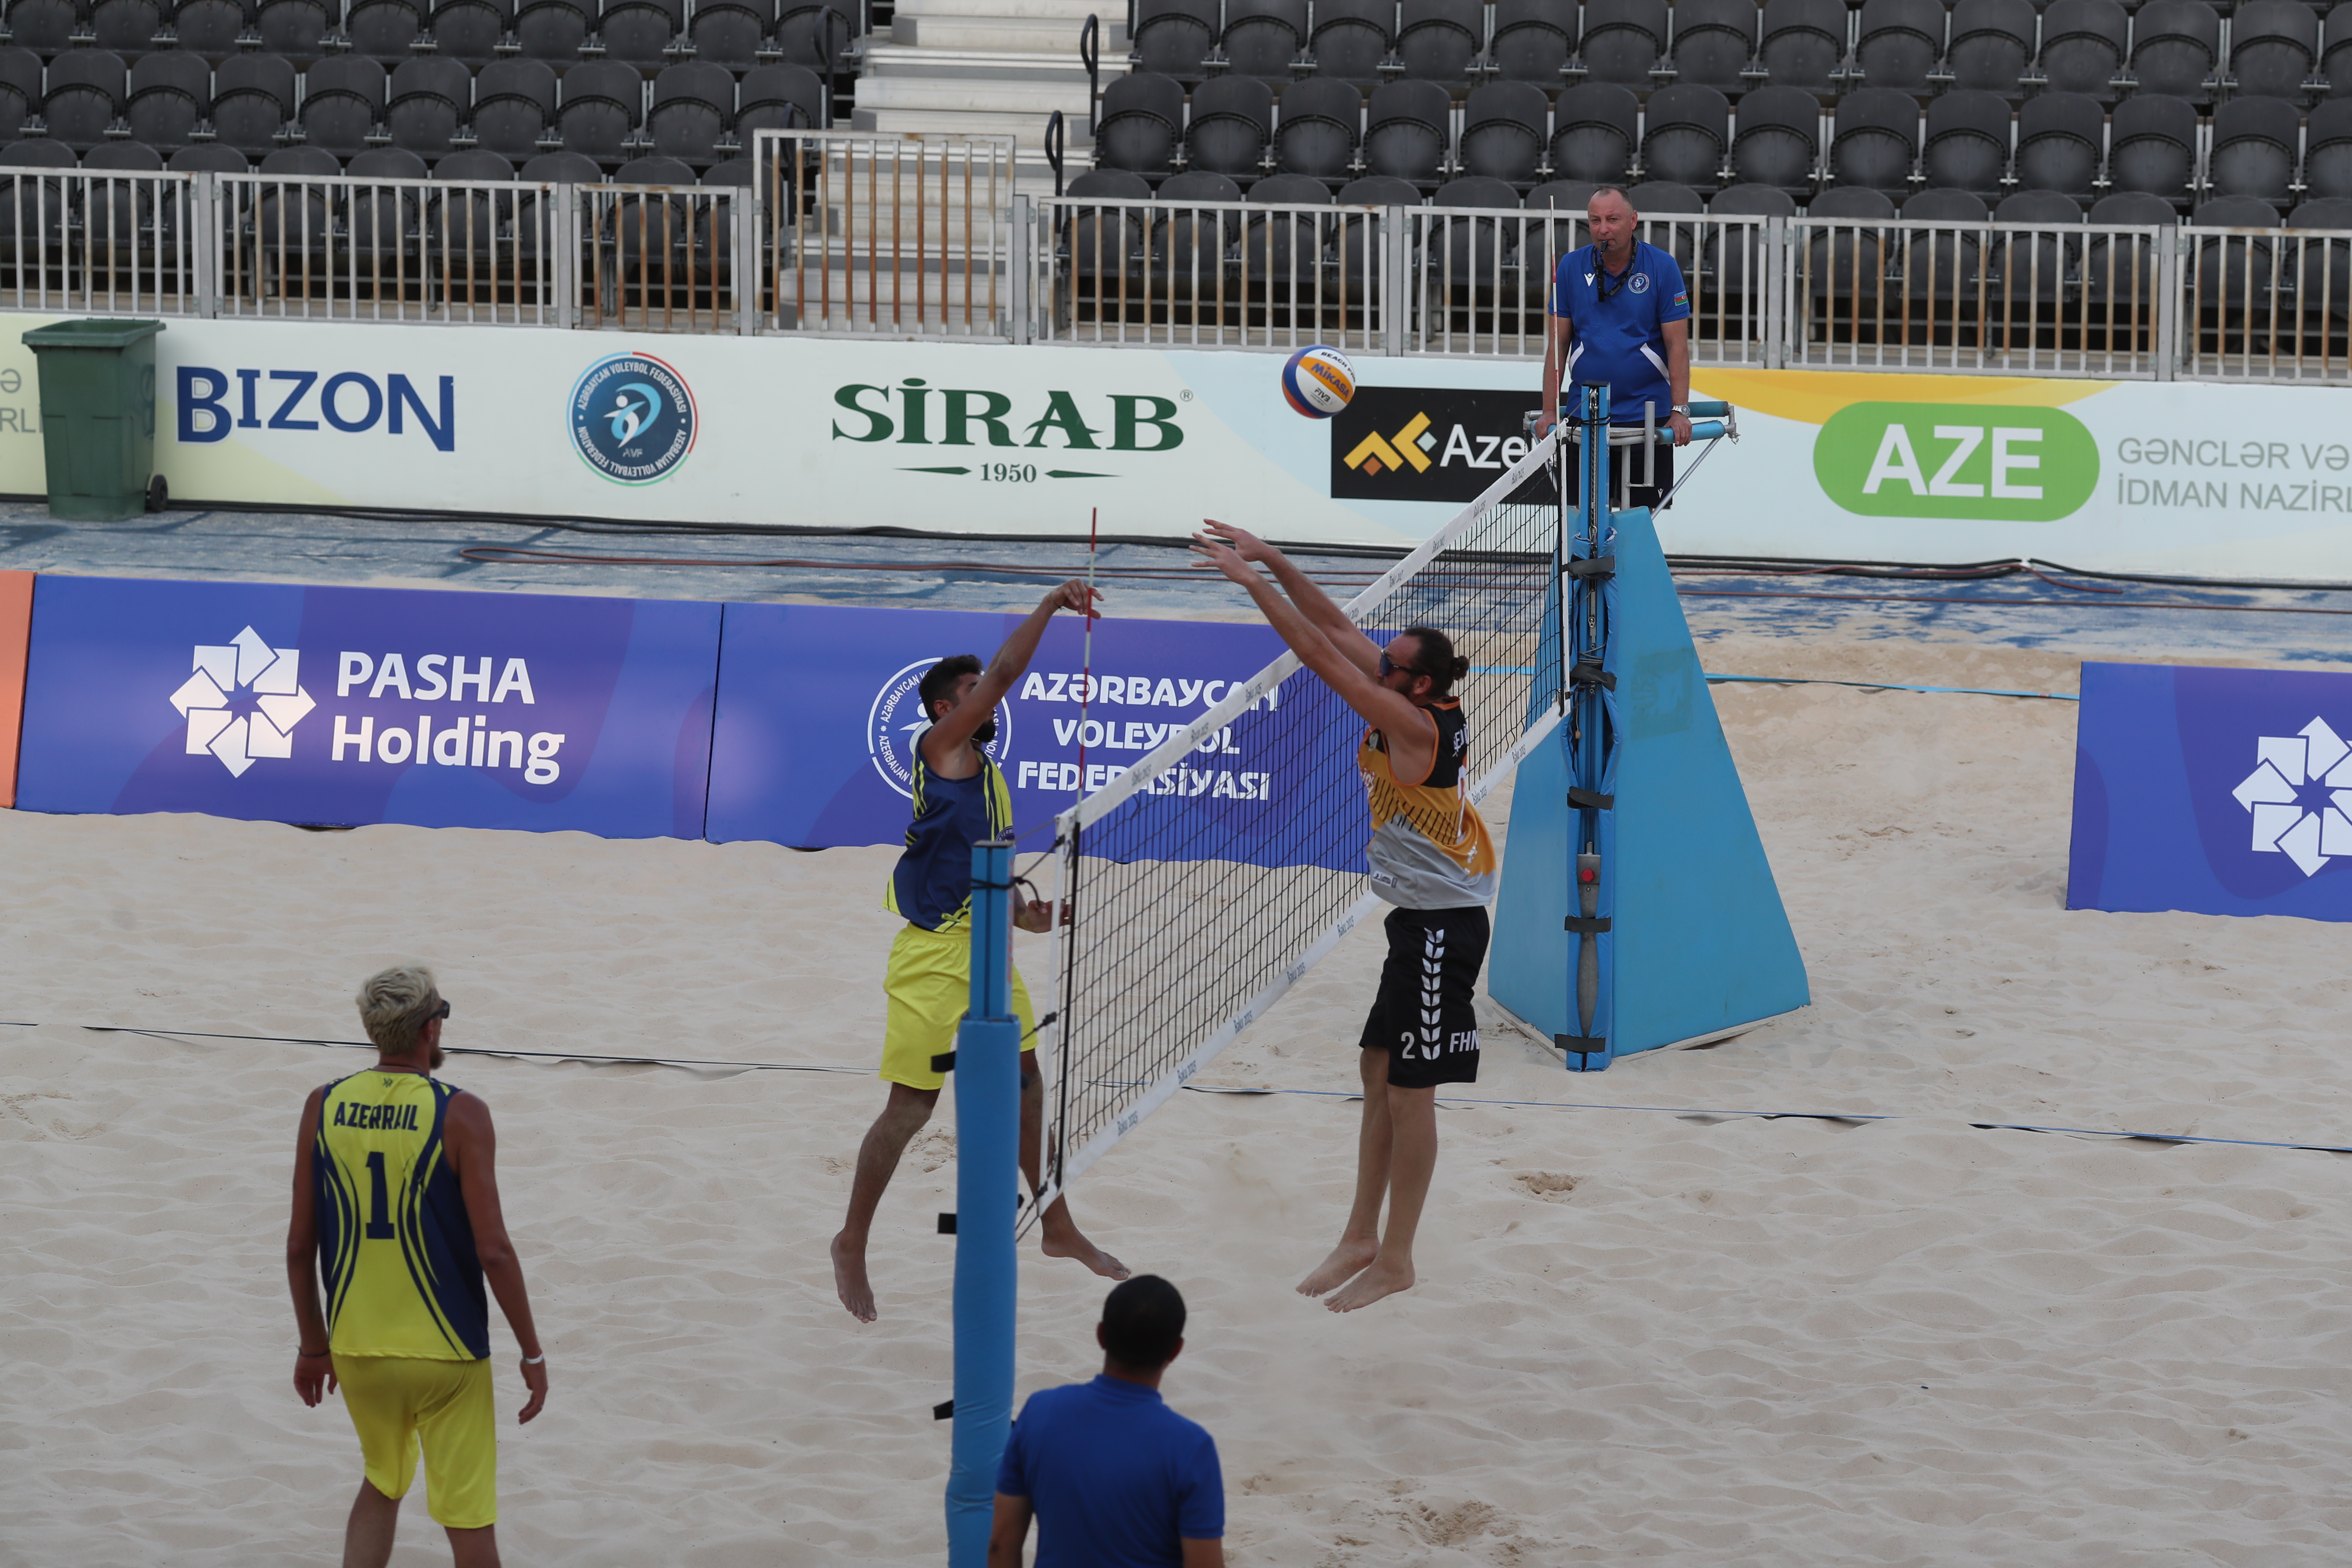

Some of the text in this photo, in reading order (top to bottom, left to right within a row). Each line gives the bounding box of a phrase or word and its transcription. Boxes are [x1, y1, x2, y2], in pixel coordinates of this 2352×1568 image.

[609, 361, 649, 374] VOLEYBOL
[177, 366, 455, 451] BIZON
[610, 461, 656, 477] VOLLEYBALL
[980, 462, 1037, 483] 1950
[1862, 423, 2043, 499] AZE
[2118, 438, 2350, 471] GƏNCLƏR VƏ
[2118, 473, 2227, 508] İDMAN
[337, 650, 535, 704] PASHA
[880, 674, 920, 723] AZƏRBAYCAN
[331, 715, 565, 784] Holding
[879, 735, 910, 782] AZERBAIJAN
[1401, 1032, 1415, 1059] 2
[334, 1102, 419, 1131] AZERRAIL
[366, 1151, 395, 1240] 1
